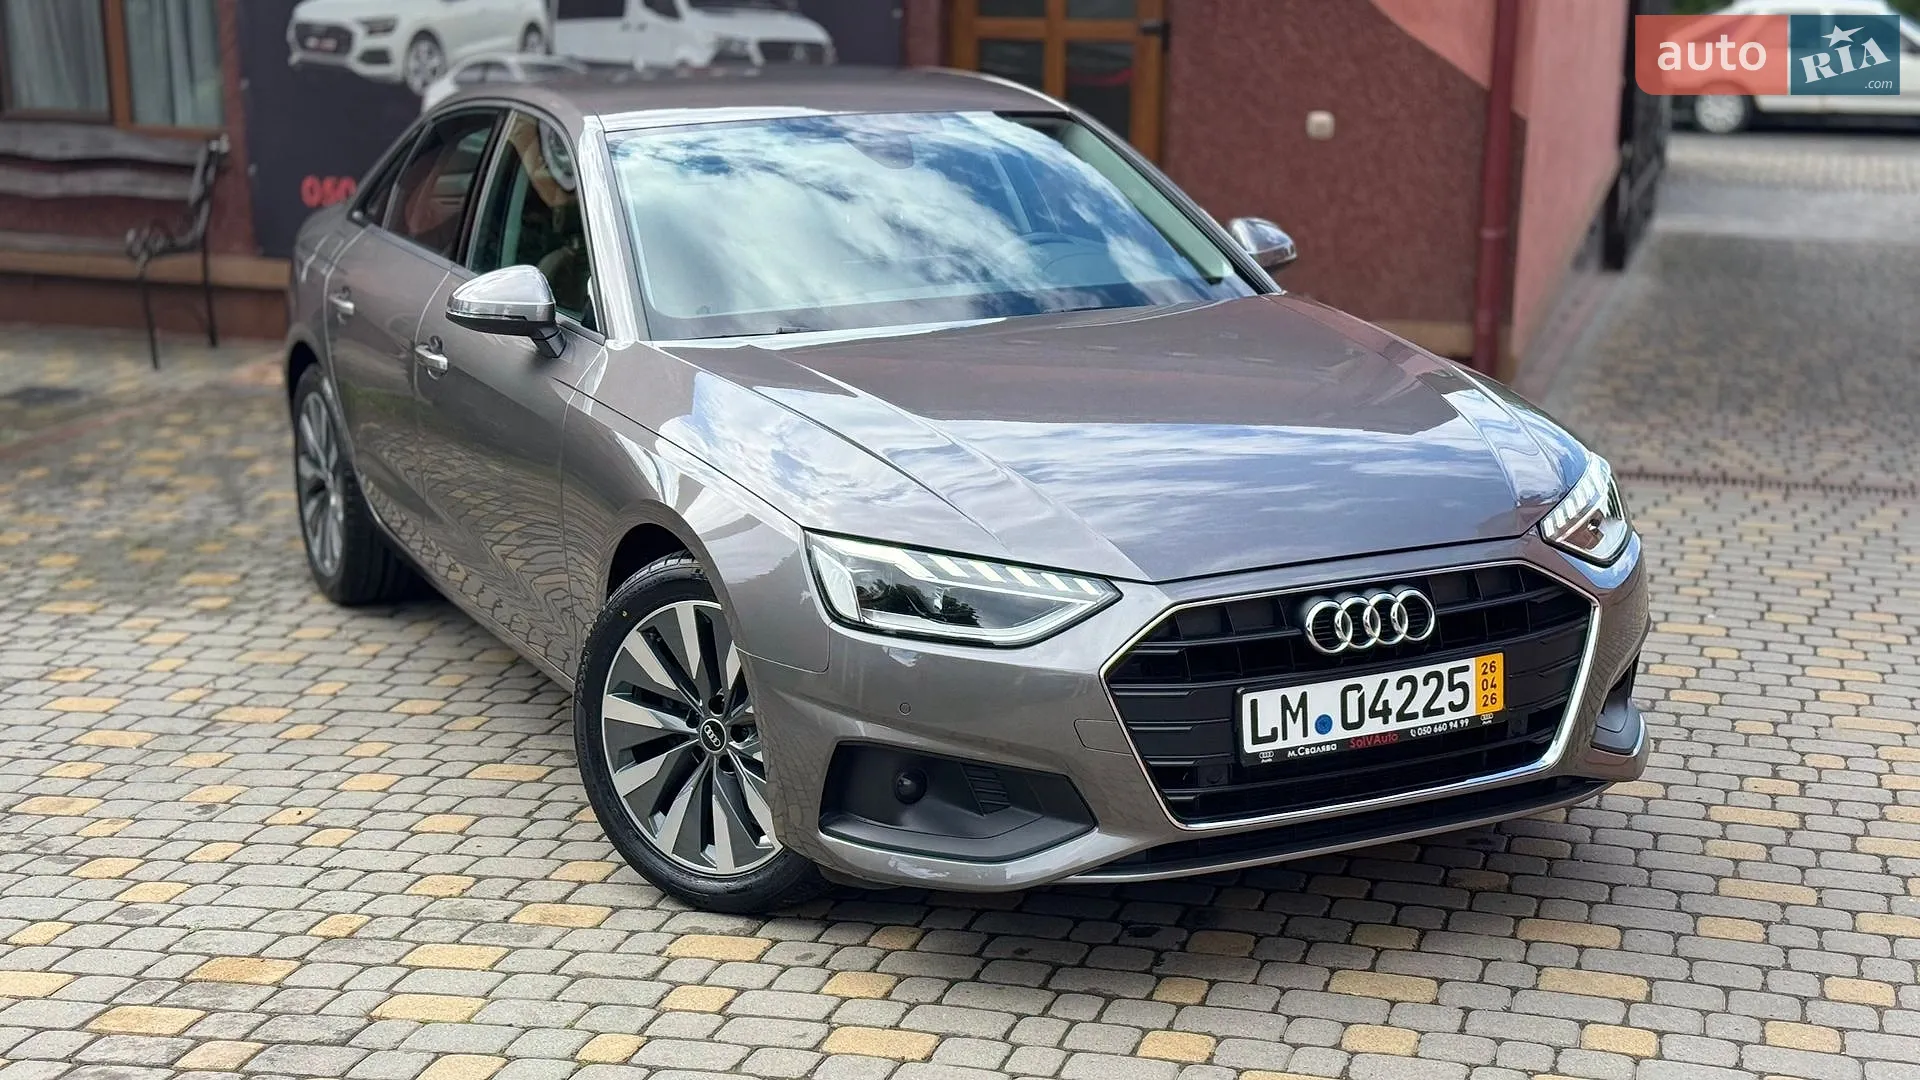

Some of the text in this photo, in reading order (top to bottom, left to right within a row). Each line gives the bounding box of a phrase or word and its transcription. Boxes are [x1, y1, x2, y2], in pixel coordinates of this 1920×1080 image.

[1481, 661, 1497, 675] 26
[1481, 677, 1497, 691] 04
[1250, 664, 1470, 746] LM 04225
[1482, 693, 1498, 707] 26
[1417, 725, 1432, 736] 050
[1433, 723, 1447, 733] 660
[1449, 721, 1458, 730] 94
[1460, 718, 1470, 727] 99
